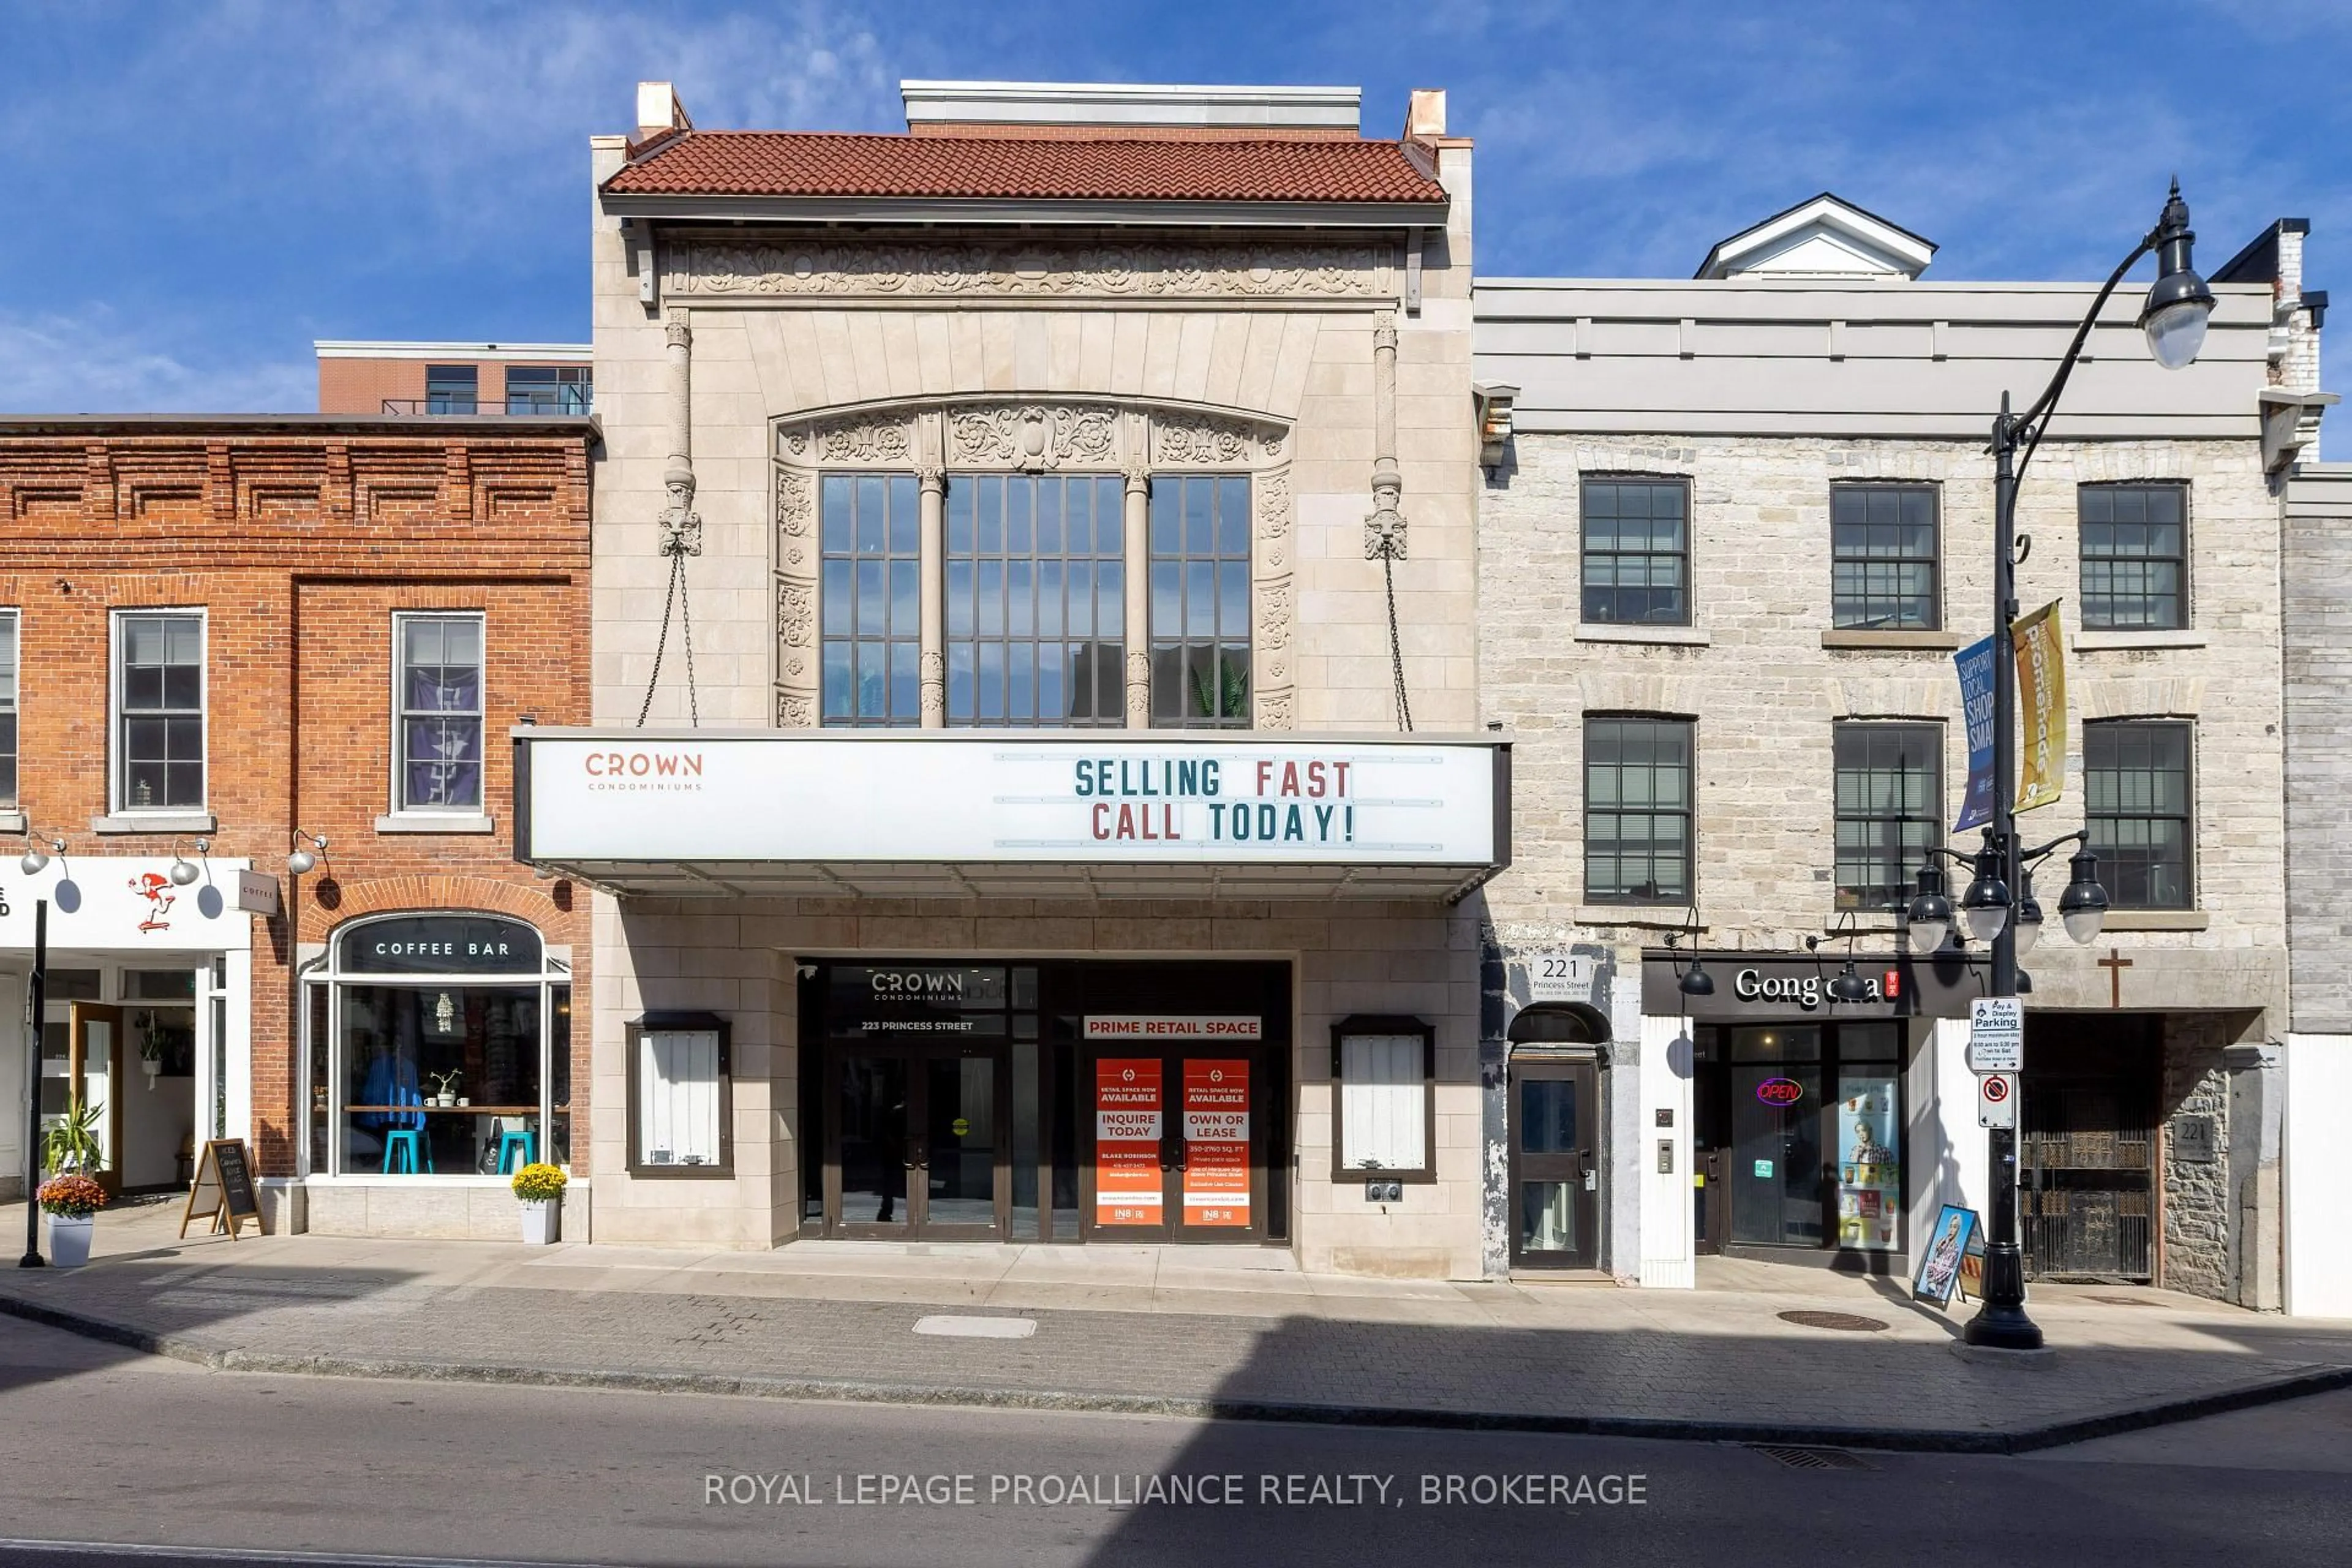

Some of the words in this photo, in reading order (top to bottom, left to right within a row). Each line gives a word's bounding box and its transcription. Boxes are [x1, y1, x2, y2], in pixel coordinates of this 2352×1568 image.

[1960, 650, 1991, 680] SUPPORT
[1963, 675, 1988, 701] LOCAL
[2026, 624, 2047, 774] promenade
[1967, 692, 1994, 726] SHOP
[585, 753, 702, 776] CROWN
[1076, 759, 1219, 796] SELLING
[1256, 760, 1350, 797] FAST
[1092, 803, 1180, 840] CALL
[1209, 804, 1354, 842] TODAY!
[375, 943, 452, 955] COFFEE
[469, 943, 508, 955] BAR
[1543, 959, 1577, 978] 221
[872, 973, 962, 992] CROWN
[1736, 969, 1819, 1005] Gong
[862, 1022, 880, 1030] 223
[882, 1022, 932, 1030] PRINCESS
[935, 1022, 973, 1030] STREET
[1090, 1022, 1140, 1033] PRIME
[1146, 1022, 1200, 1034] RETAIL
[1206, 1023, 1257, 1035] SPACE
[1976, 1018, 2017, 1028] Parking
[1759, 1085, 1798, 1099] OPEN
[1102, 1115, 1155, 1125] INQUIRE
[1189, 1115, 1221, 1125] OWN
[1226, 1115, 1244, 1125] OR
[1107, 1127, 1150, 1136] TODAY
[1197, 1128, 1236, 1137] LEASE
[2181, 1123, 2204, 1140] 221
